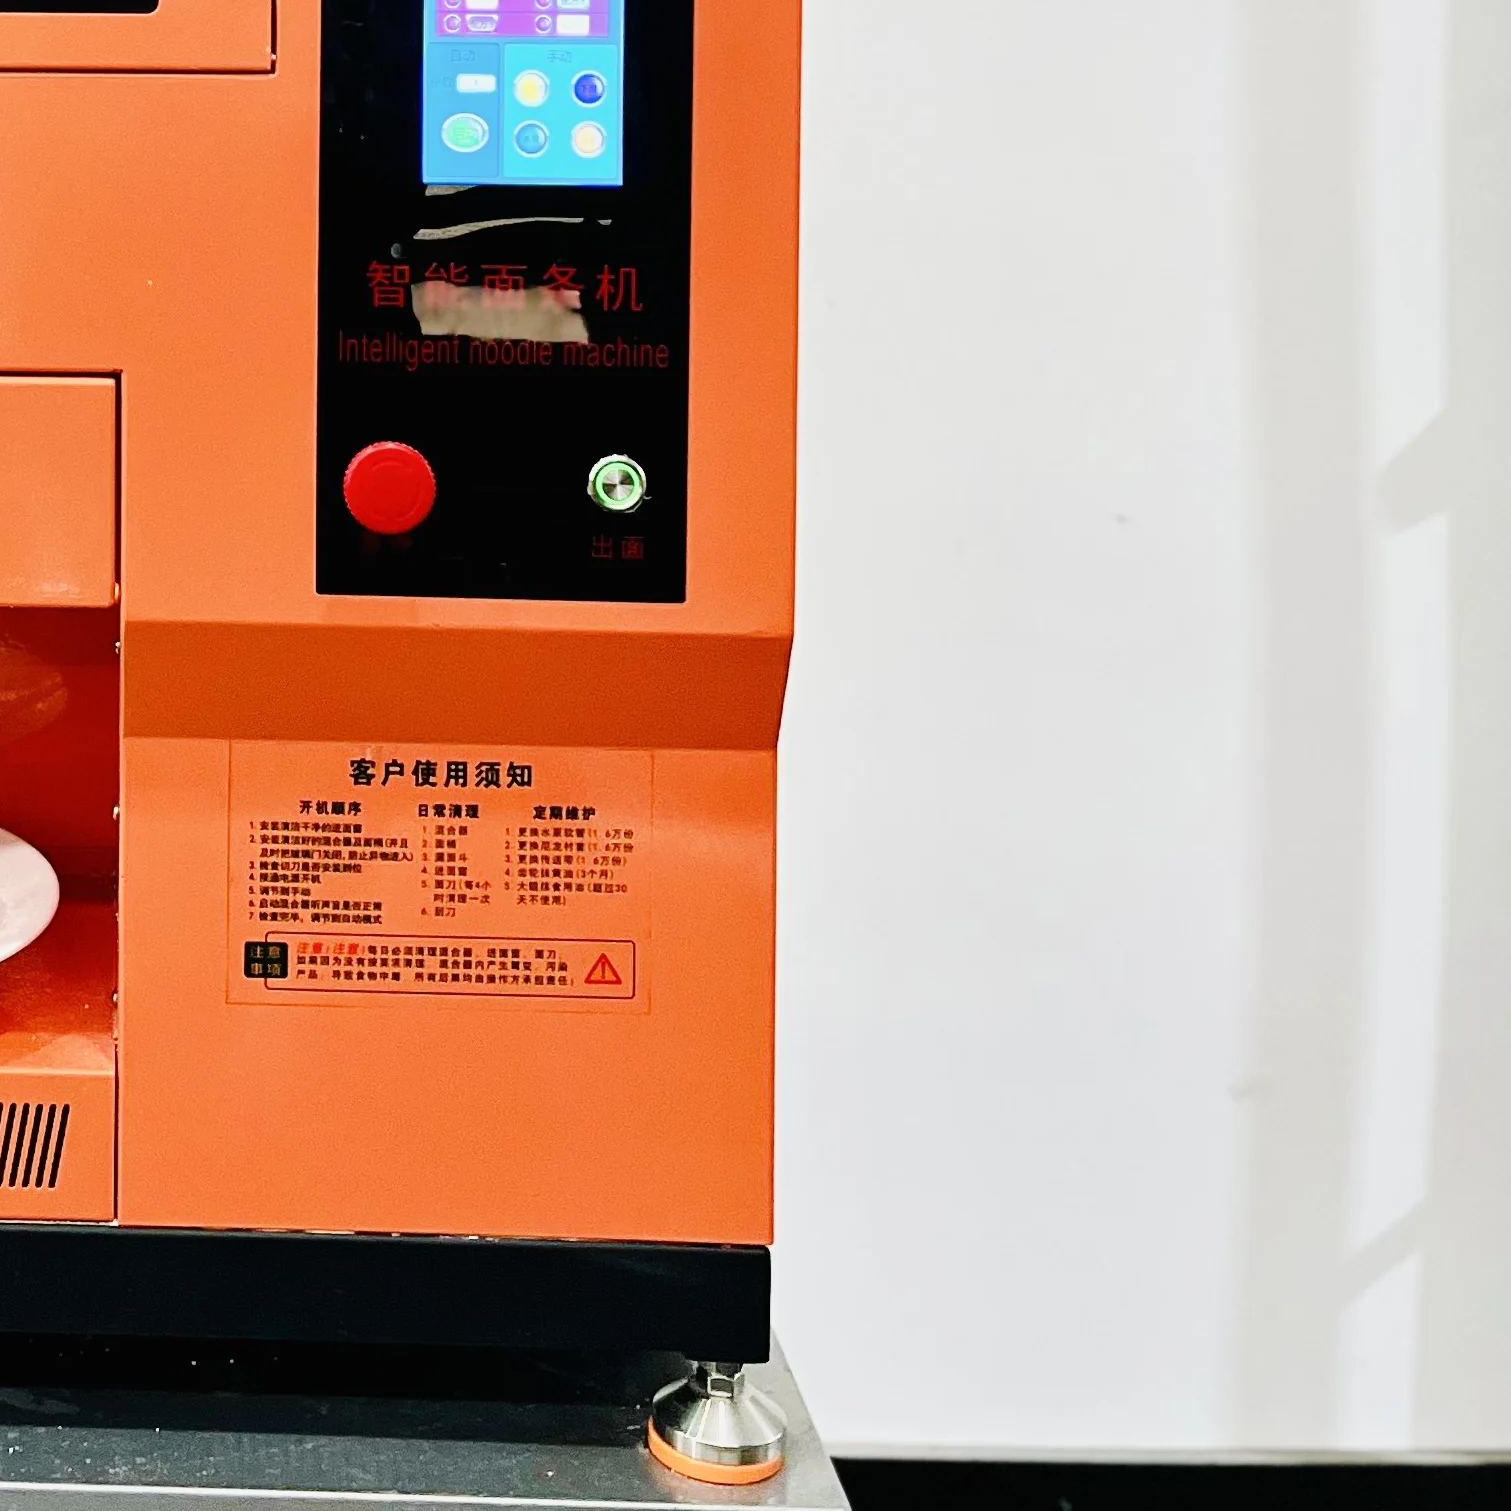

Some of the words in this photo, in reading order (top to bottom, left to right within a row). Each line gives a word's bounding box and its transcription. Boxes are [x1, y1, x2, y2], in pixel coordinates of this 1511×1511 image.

[338, 330, 460, 372] Intelligent
[469, 337, 553, 366] noodle
[563, 336, 670, 369] machine
[349, 758, 533, 788] 客户使用须知
[299, 800, 362, 816] 开机顺序
[418, 804, 479, 819] 日常清理
[533, 805, 596, 821] 定期维护
[249, 945, 281, 959] 注意
[250, 963, 281, 976] 事项
